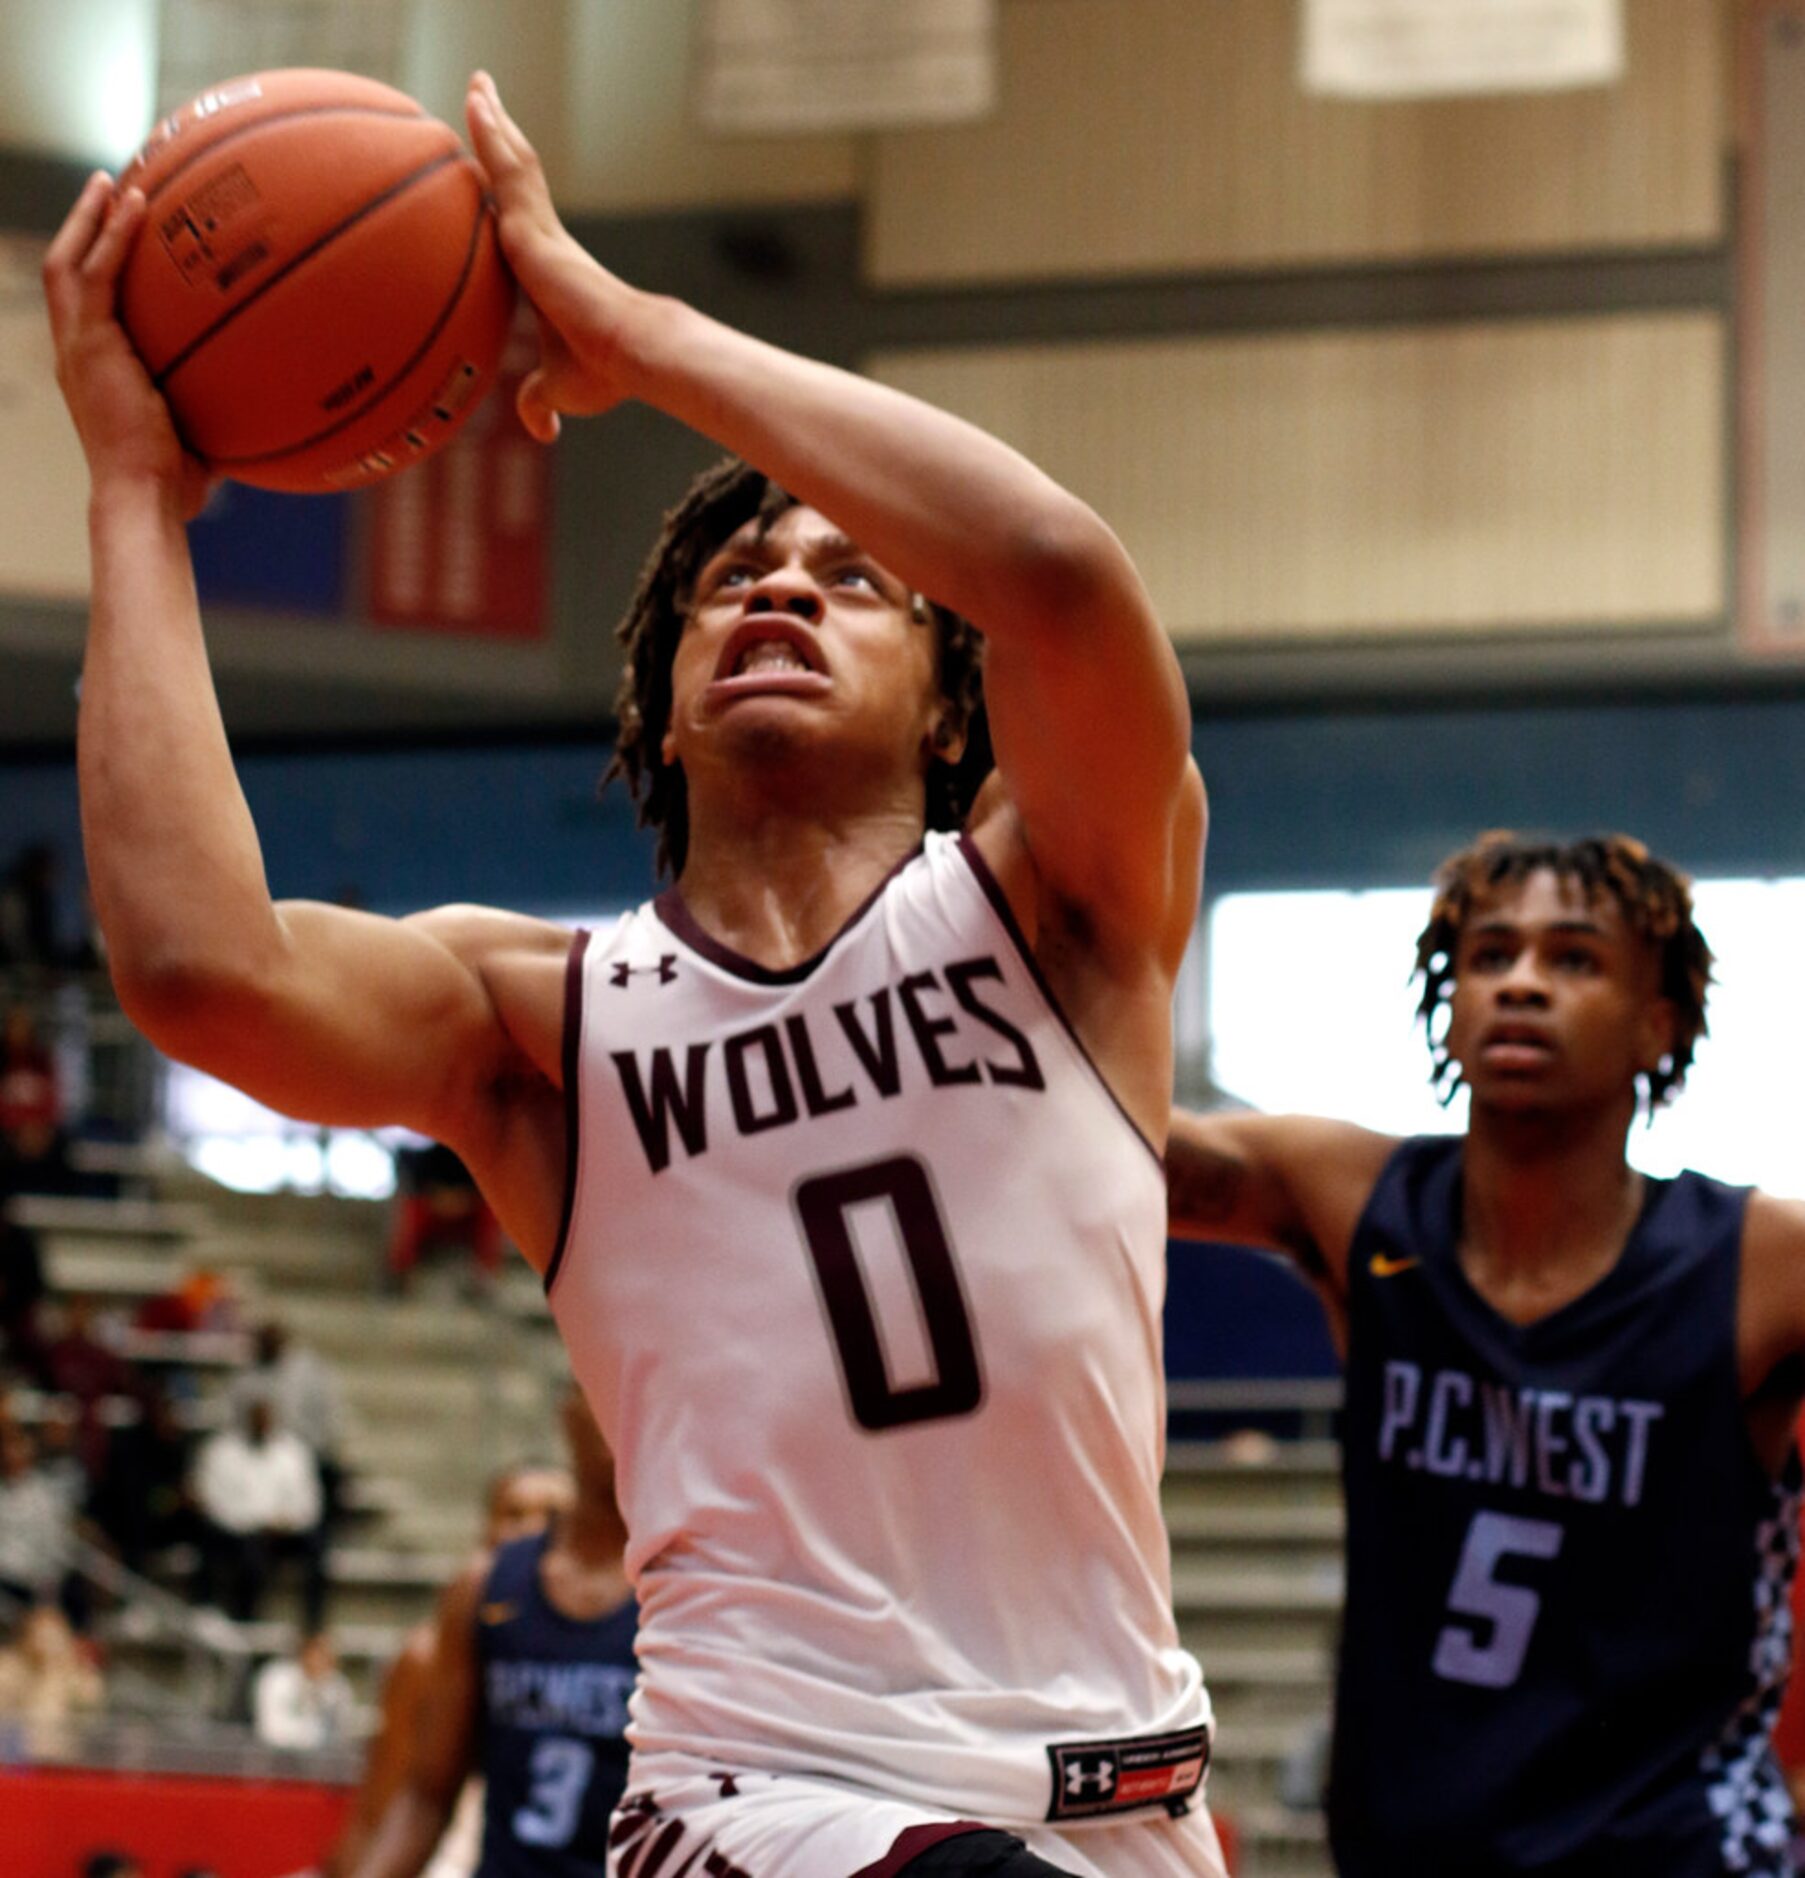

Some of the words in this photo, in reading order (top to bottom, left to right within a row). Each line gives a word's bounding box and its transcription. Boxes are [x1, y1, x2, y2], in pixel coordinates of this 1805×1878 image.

[610, 955, 1046, 1176] WOLVES
[791, 1149, 988, 1435] 0
[1431, 1510, 1564, 1689] 5
[512, 1737, 595, 1847] 3
